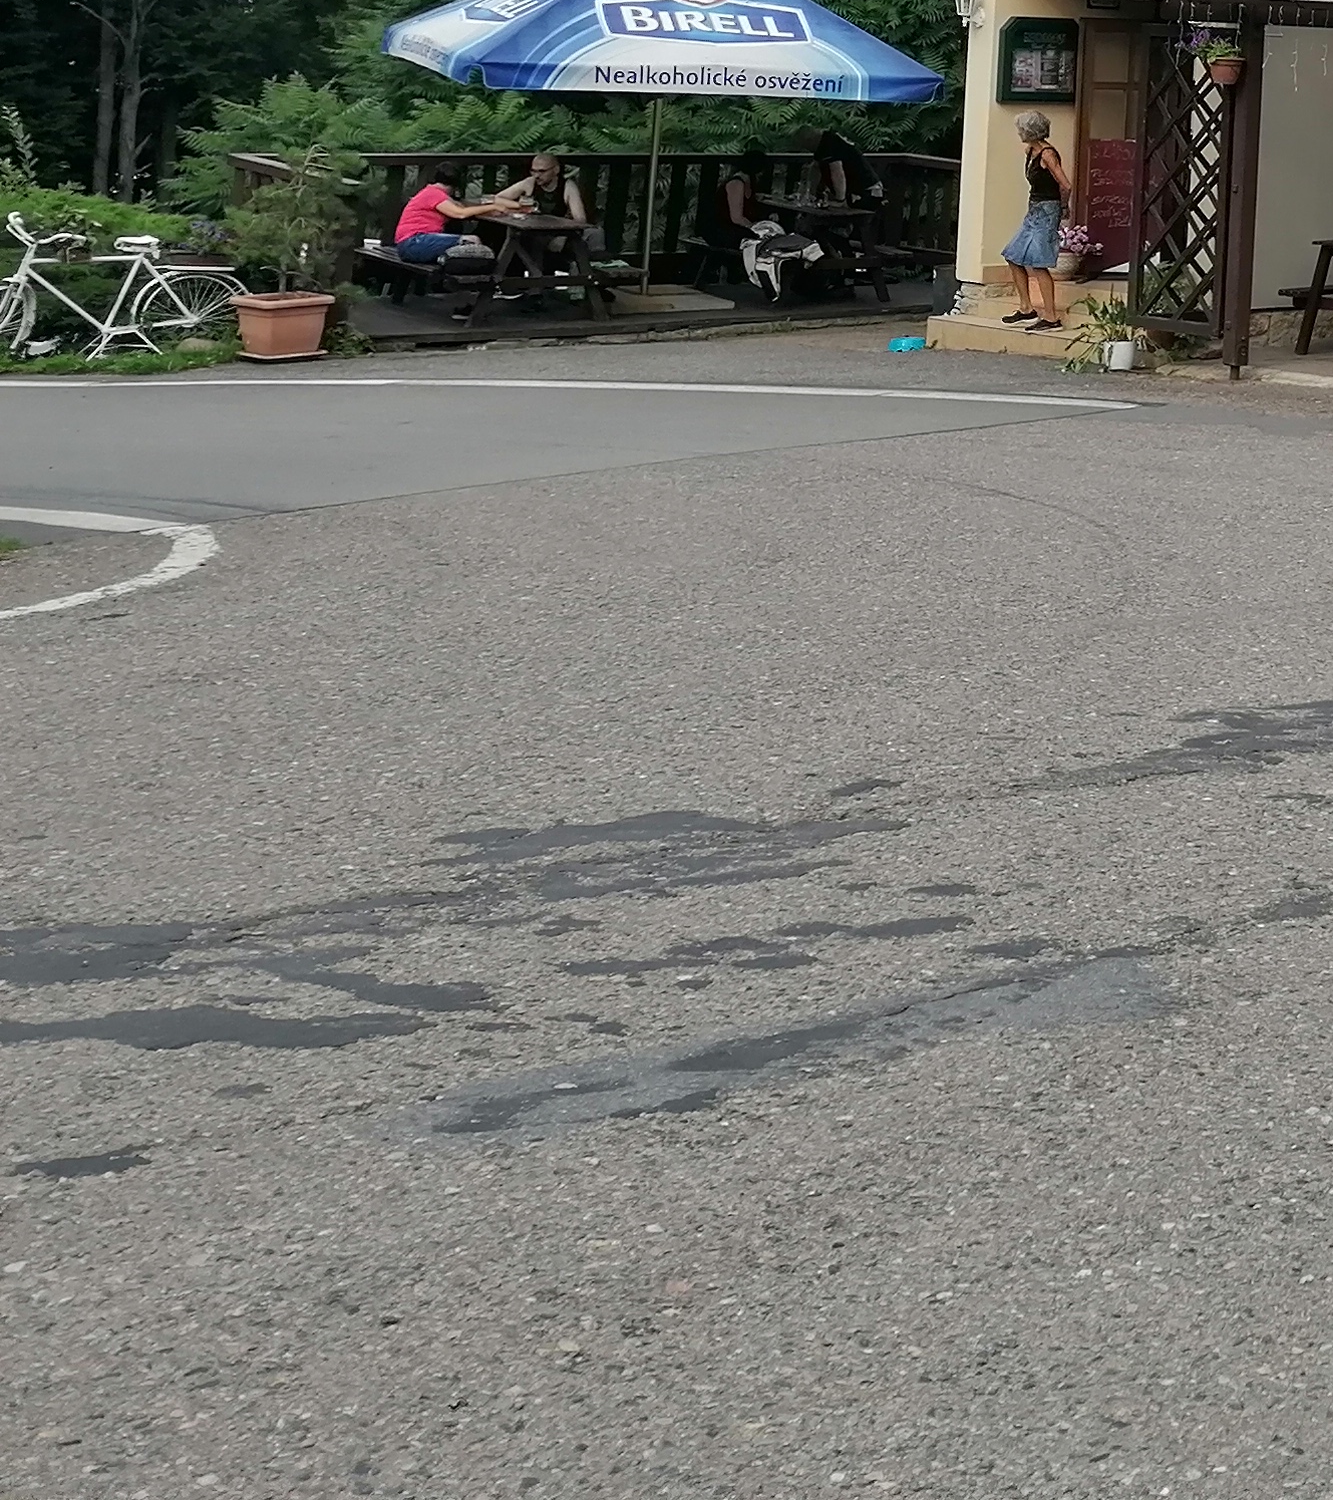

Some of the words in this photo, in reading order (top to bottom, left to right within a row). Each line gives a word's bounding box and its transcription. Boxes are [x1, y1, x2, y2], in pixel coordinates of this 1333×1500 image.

[620, 5, 795, 38] BIRELL
[594, 65, 747, 88] Nealkoholické
[754, 72, 845, 94] osvěžení
